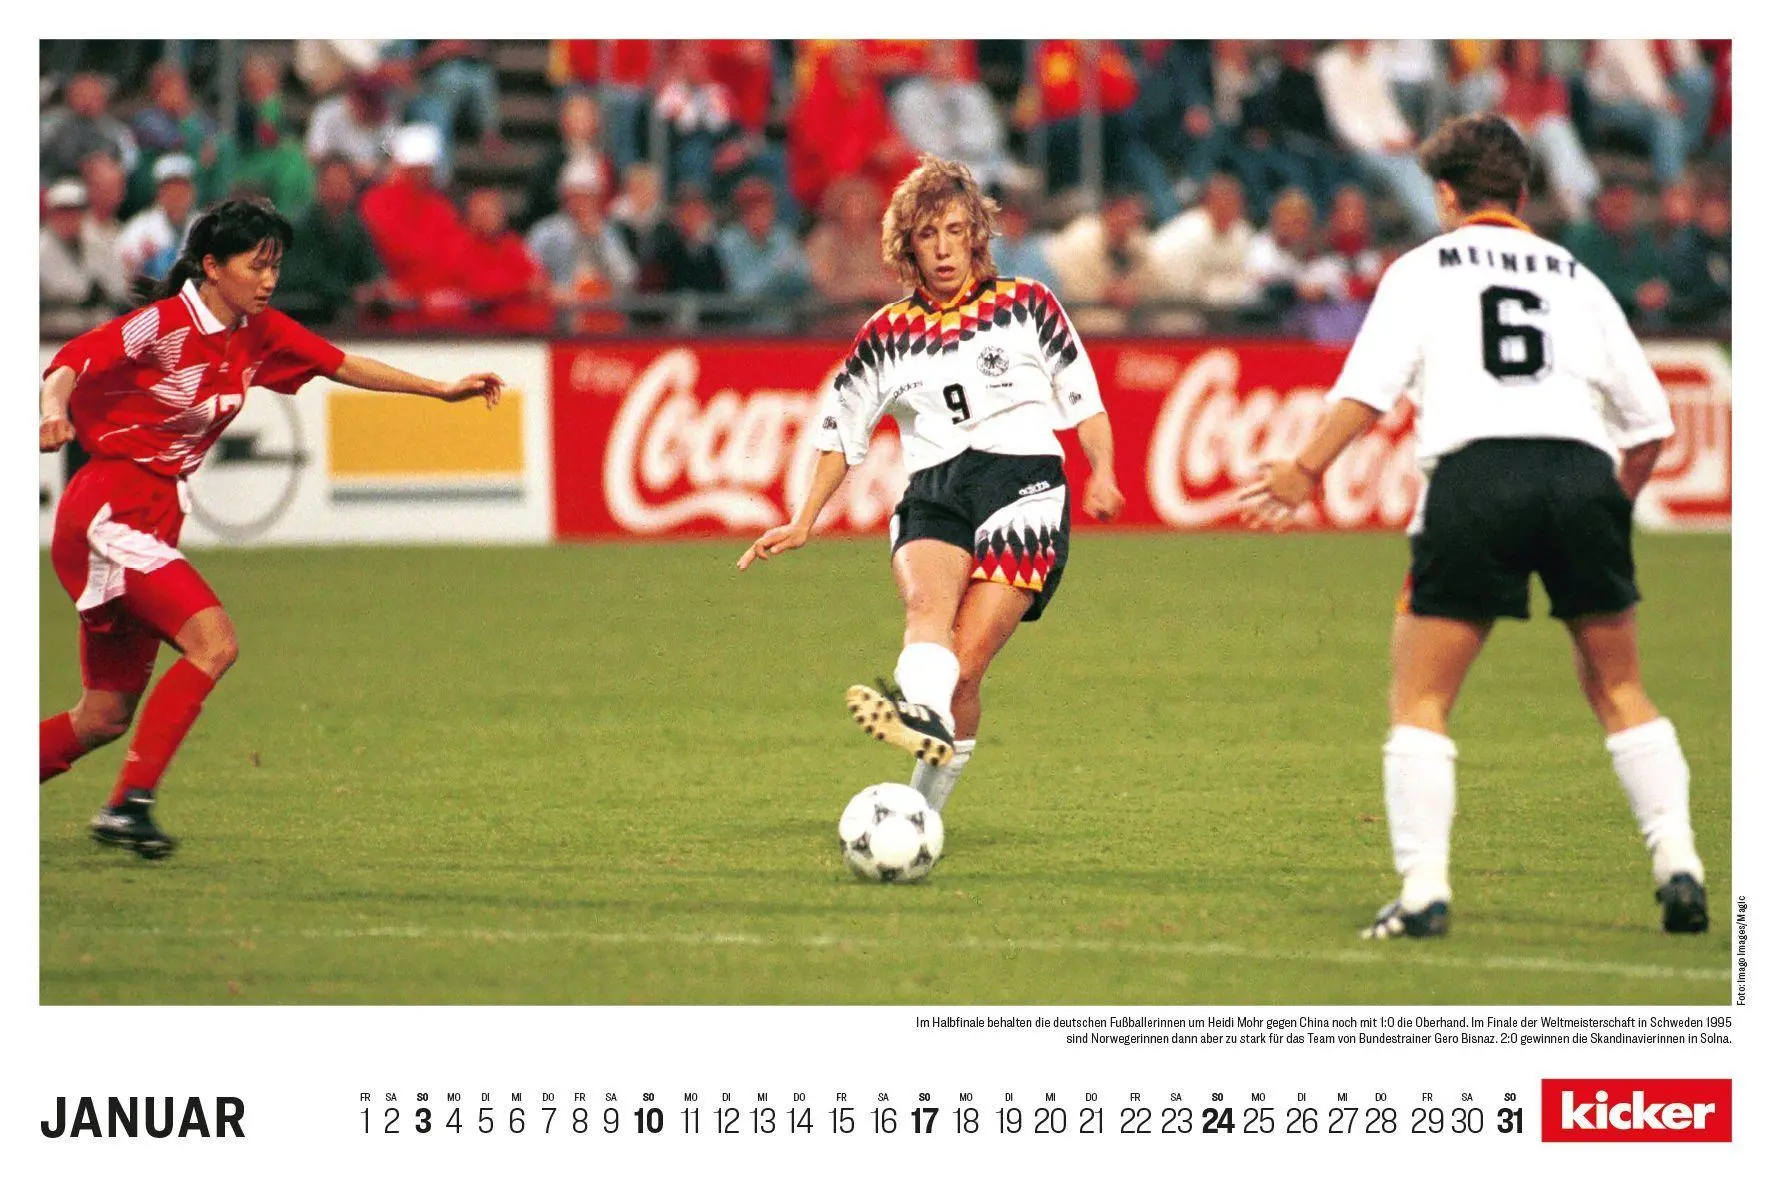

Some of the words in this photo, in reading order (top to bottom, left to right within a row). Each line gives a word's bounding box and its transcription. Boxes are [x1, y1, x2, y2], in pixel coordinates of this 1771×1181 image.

[1439, 246, 1578, 279] MEINERT
[1480, 284, 1550, 384] 6
[943, 383, 971, 425] 9
[1018, 480, 1051, 496] adidas
